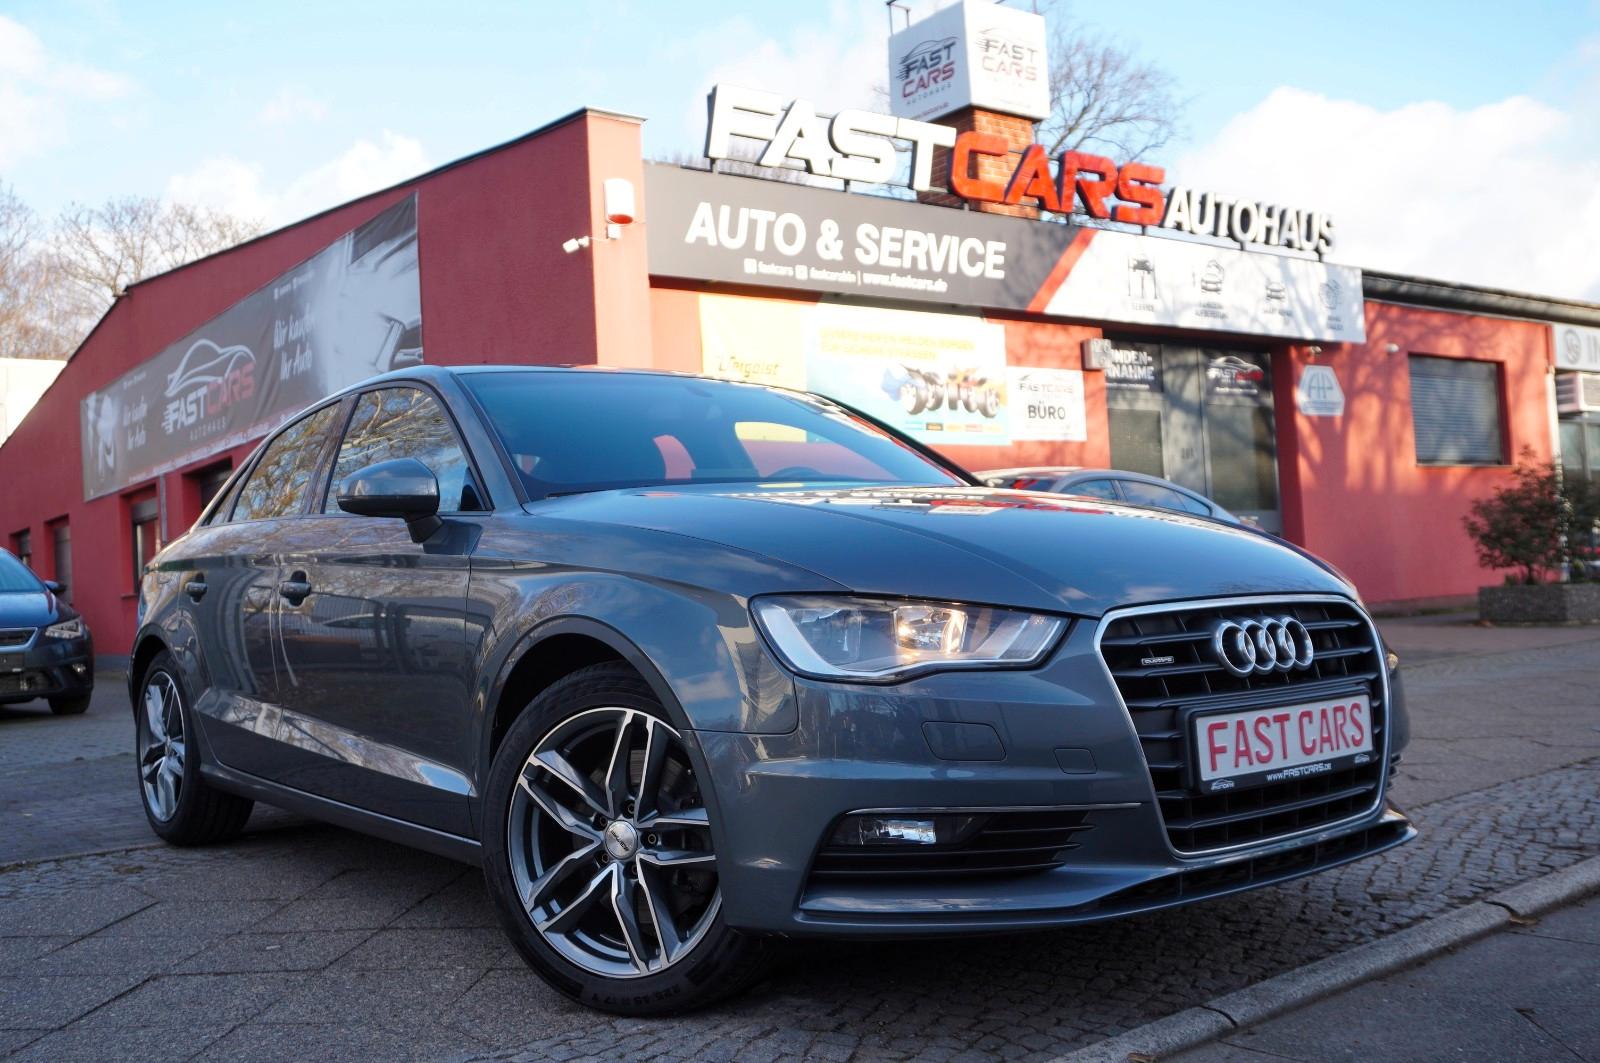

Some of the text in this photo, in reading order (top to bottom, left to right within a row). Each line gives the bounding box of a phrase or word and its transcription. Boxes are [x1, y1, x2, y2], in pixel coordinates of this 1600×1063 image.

[898, 41, 957, 80] FAST
[977, 39, 1039, 62] FAST
[981, 55, 1038, 82] CARS
[902, 60, 956, 99] CARS
[1160, 185, 1336, 255] AUTOHAUS
[684, 201, 1007, 280] AUTO & SERVICE
[1028, 400, 1067, 420] BÜRO
[1207, 703, 1365, 772] FAST CARS
